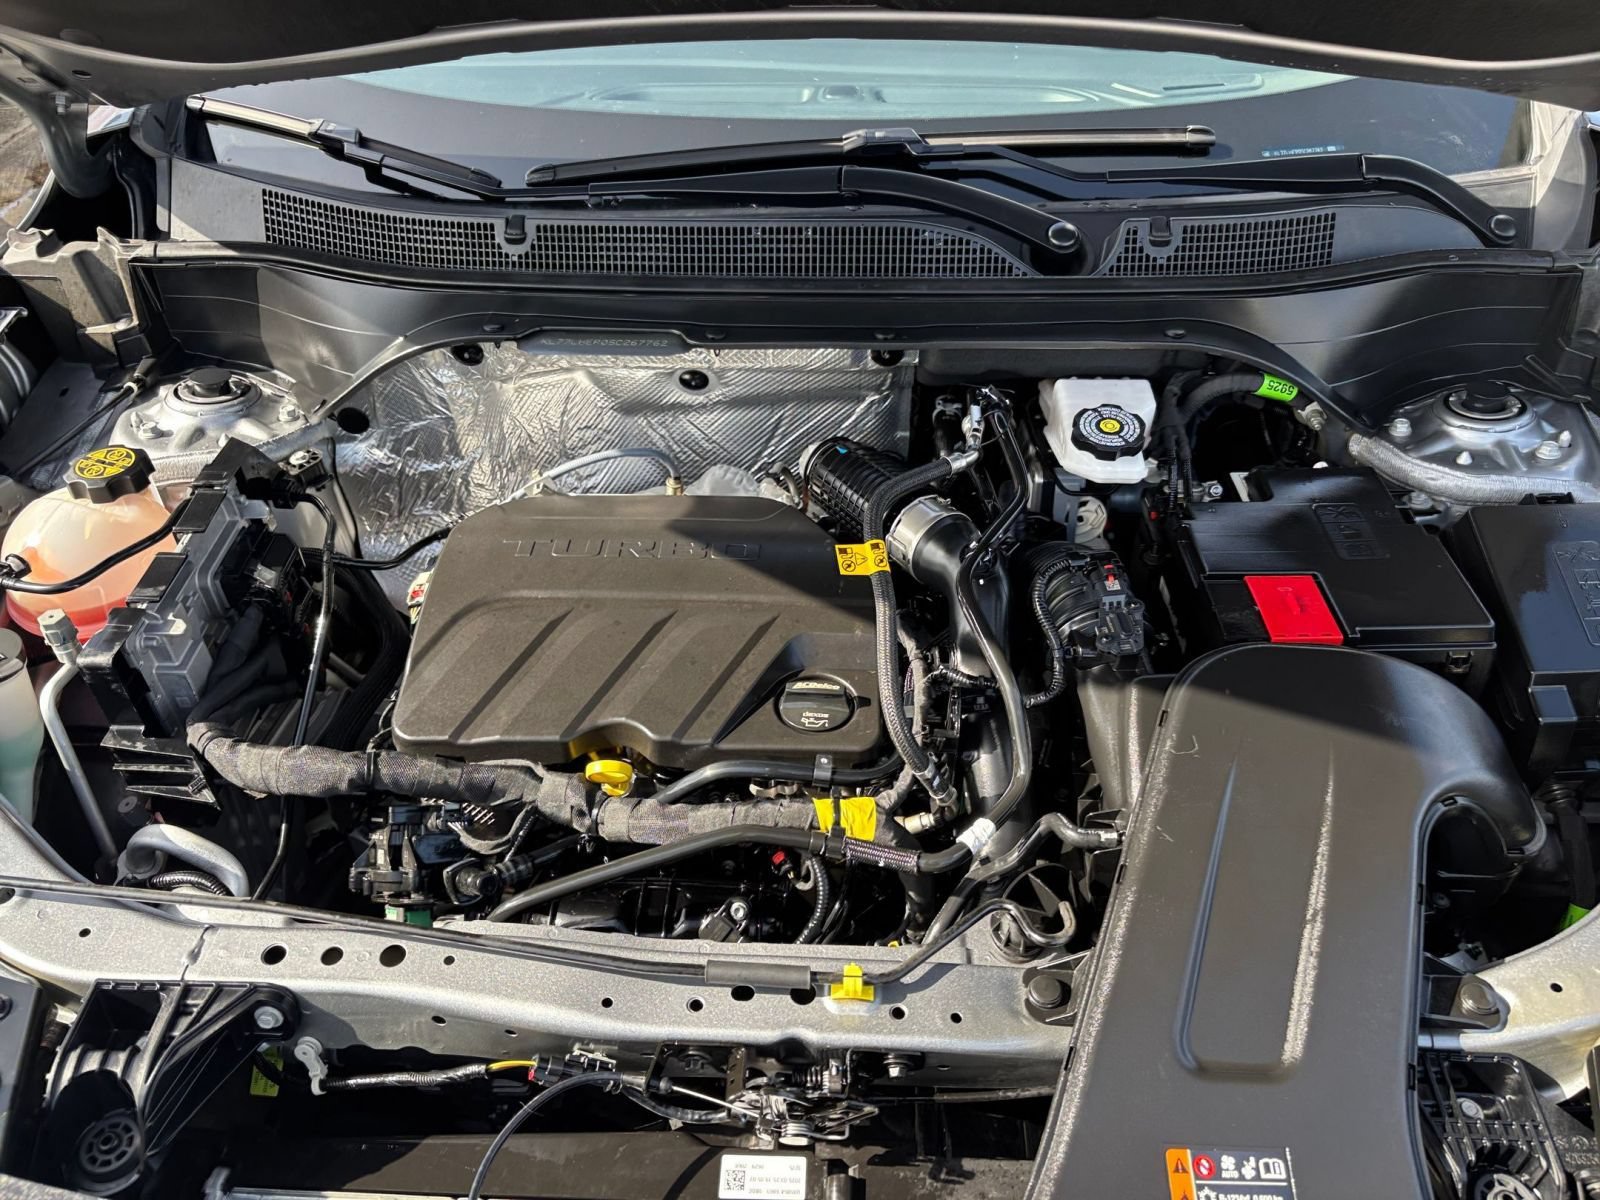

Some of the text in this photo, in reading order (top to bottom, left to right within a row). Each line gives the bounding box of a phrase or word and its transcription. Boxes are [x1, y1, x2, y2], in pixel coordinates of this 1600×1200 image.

[1267, 379, 1295, 396] 5925
[502, 538, 761, 560] TURBO
[791, 681, 841, 690] ACDelco
[1221, 1170, 1240, 1179] AUTO
